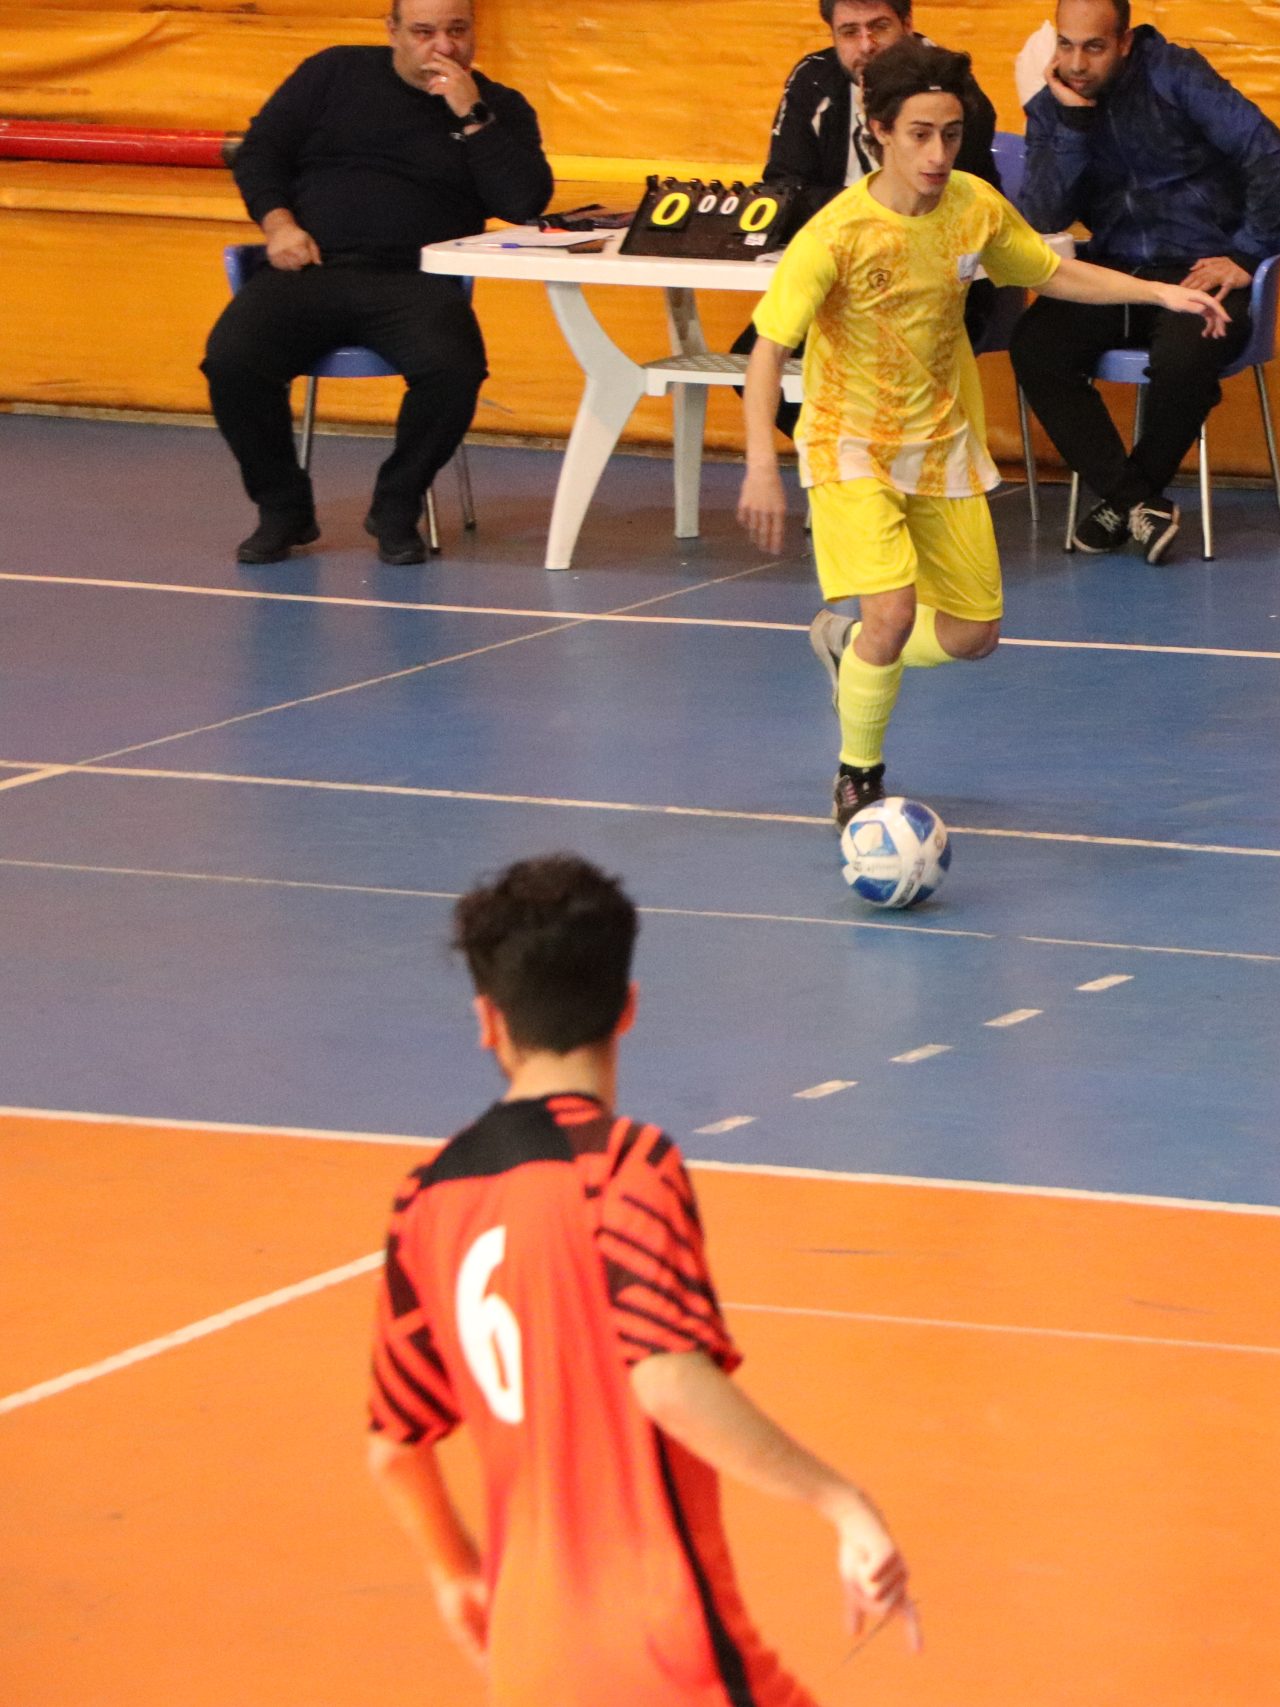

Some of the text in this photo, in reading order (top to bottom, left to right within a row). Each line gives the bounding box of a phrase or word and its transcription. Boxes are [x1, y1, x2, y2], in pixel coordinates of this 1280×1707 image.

[651, 192, 690, 225] 0
[739, 197, 778, 231] 0
[455, 1224, 525, 1424] 6
